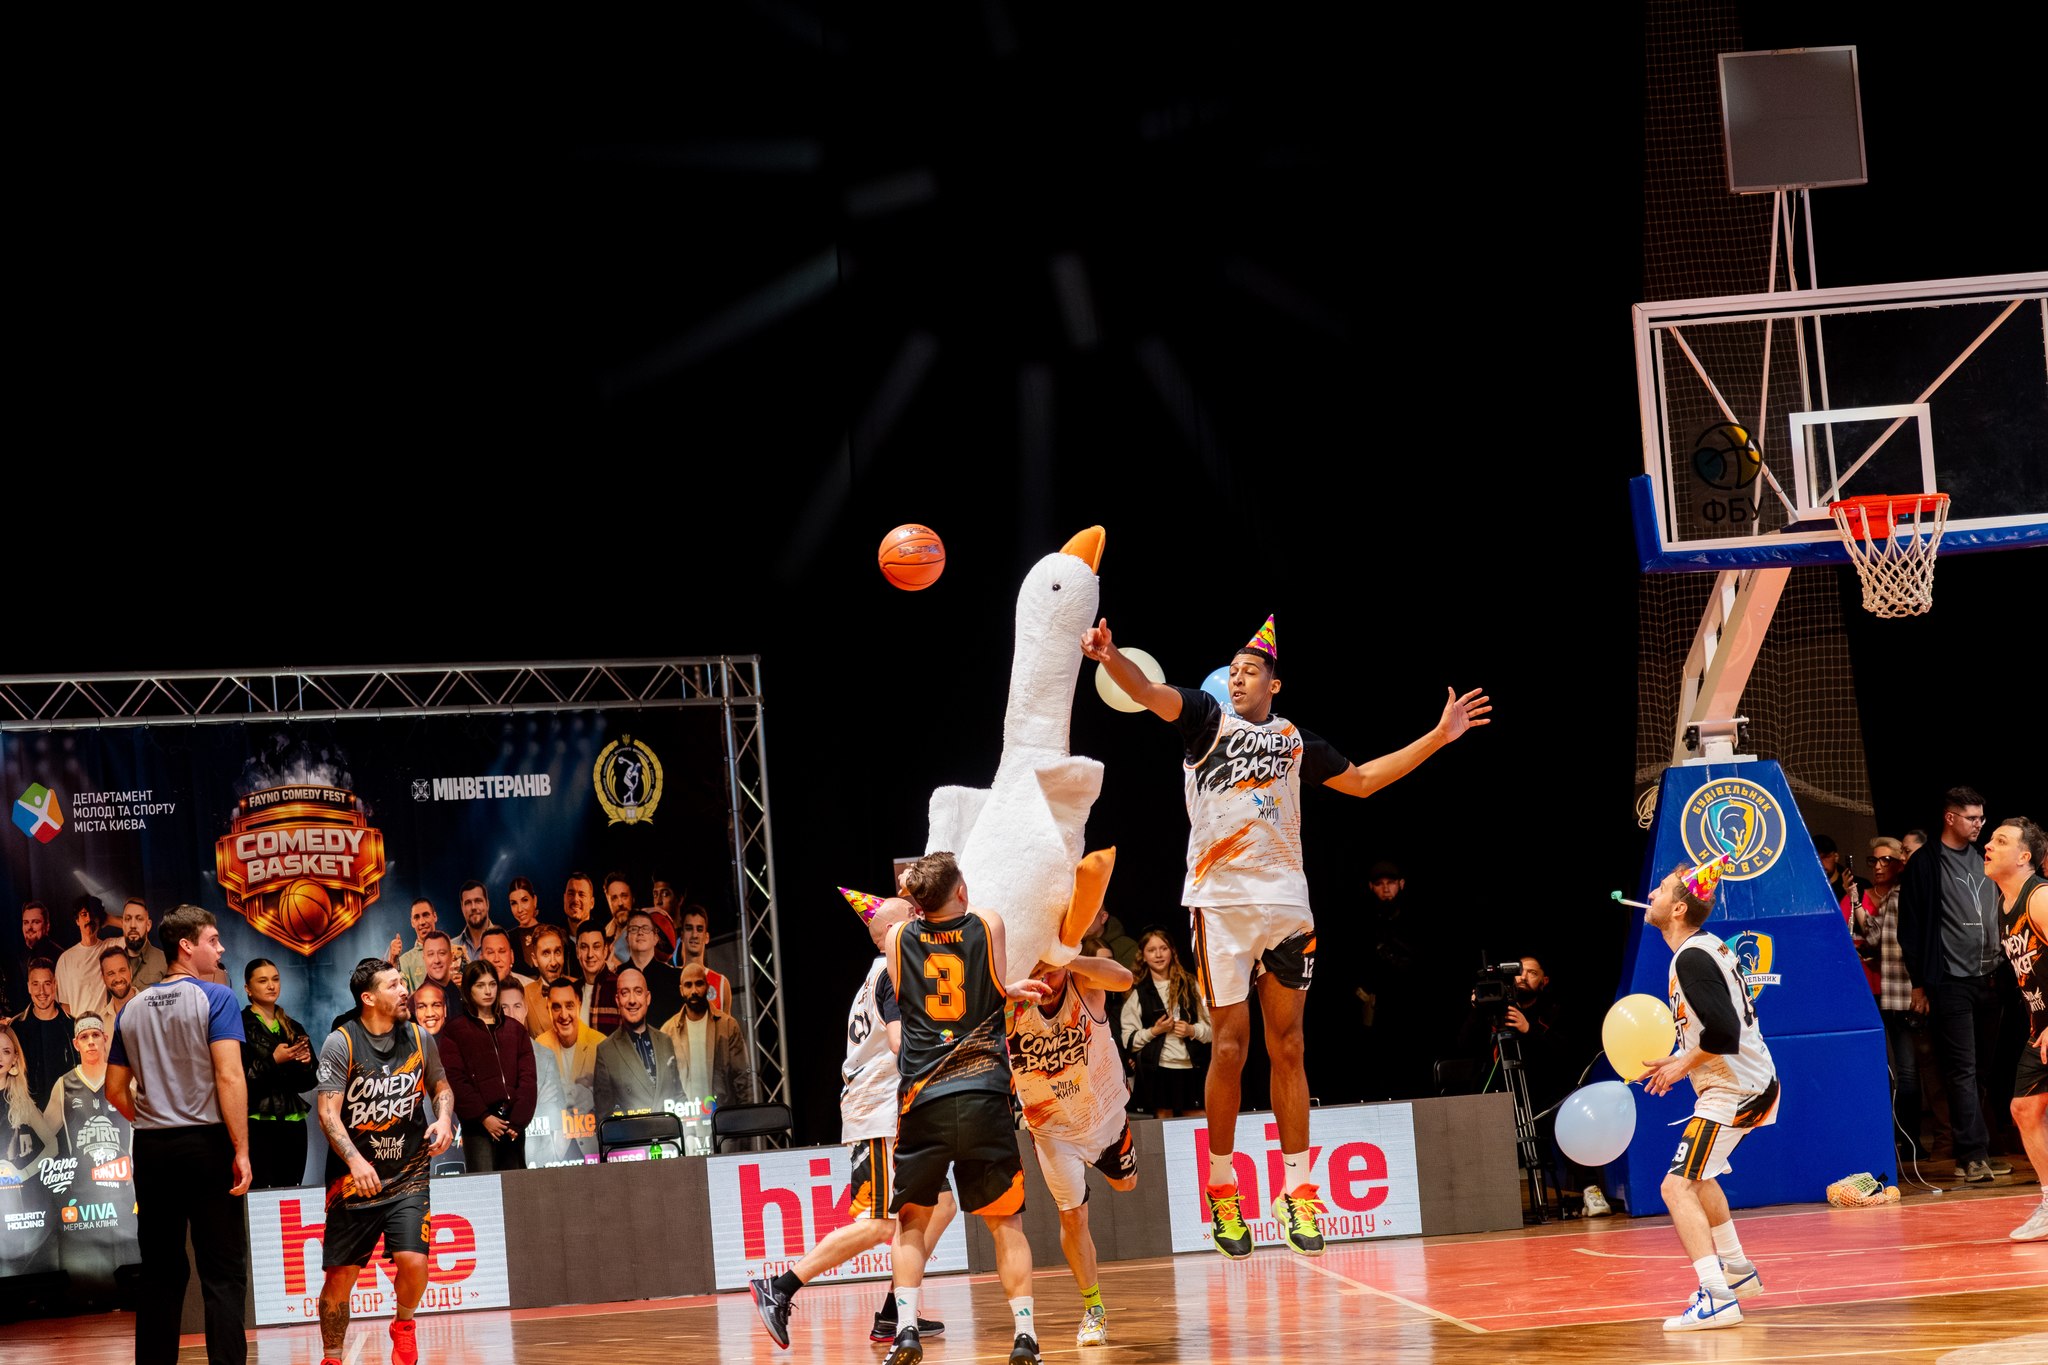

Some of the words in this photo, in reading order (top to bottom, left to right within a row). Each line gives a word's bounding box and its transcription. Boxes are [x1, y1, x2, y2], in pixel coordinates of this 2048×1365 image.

[1703, 496, 1764, 524] ФБУ
[73, 790, 153, 806] ДЕПАРТАМЕНТ
[249, 792, 280, 807] FAYNO
[282, 789, 321, 801] COMEDY
[323, 789, 346, 804] FEST
[433, 774, 552, 801] МІНВЕТЕРАНІВ
[73, 806, 115, 819] МОЛОДІ
[117, 805, 131, 817] ТА
[133, 803, 176, 816] СПОРТУ
[1692, 785, 1772, 815] БУДІВЕЛЬНИК
[74, 820, 107, 833] МІСТА
[109, 819, 147, 831] КИЄВА
[236, 828, 365, 860] COMEDY
[247, 853, 354, 884] BASKET
[923, 953, 967, 1021] 3
[1019, 1014, 1087, 1056] COMEDY
[1022, 1042, 1090, 1075] BASKET
[346, 1068, 422, 1103] COMEDY
[1056, 1079, 1074, 1092] ЛІГА
[347, 1091, 421, 1129] BASKET
[561, 1107, 596, 1134] hike
[76, 1126, 121, 1149] SPIRIT
[379, 1136, 398, 1149] ЛІГА
[374, 1146, 403, 1161] ЖИТТЯ
[38, 1157, 79, 1182] Papa
[43, 1170, 75, 1186] dance
[4, 1211, 46, 1222] SECURITY
[79, 1203, 118, 1222] VIVA
[7, 1219, 45, 1231] HOLDING
[63, 1221, 95, 1232] МЕРЕЖА
[95, 1218, 119, 1229] КЛІНІК
